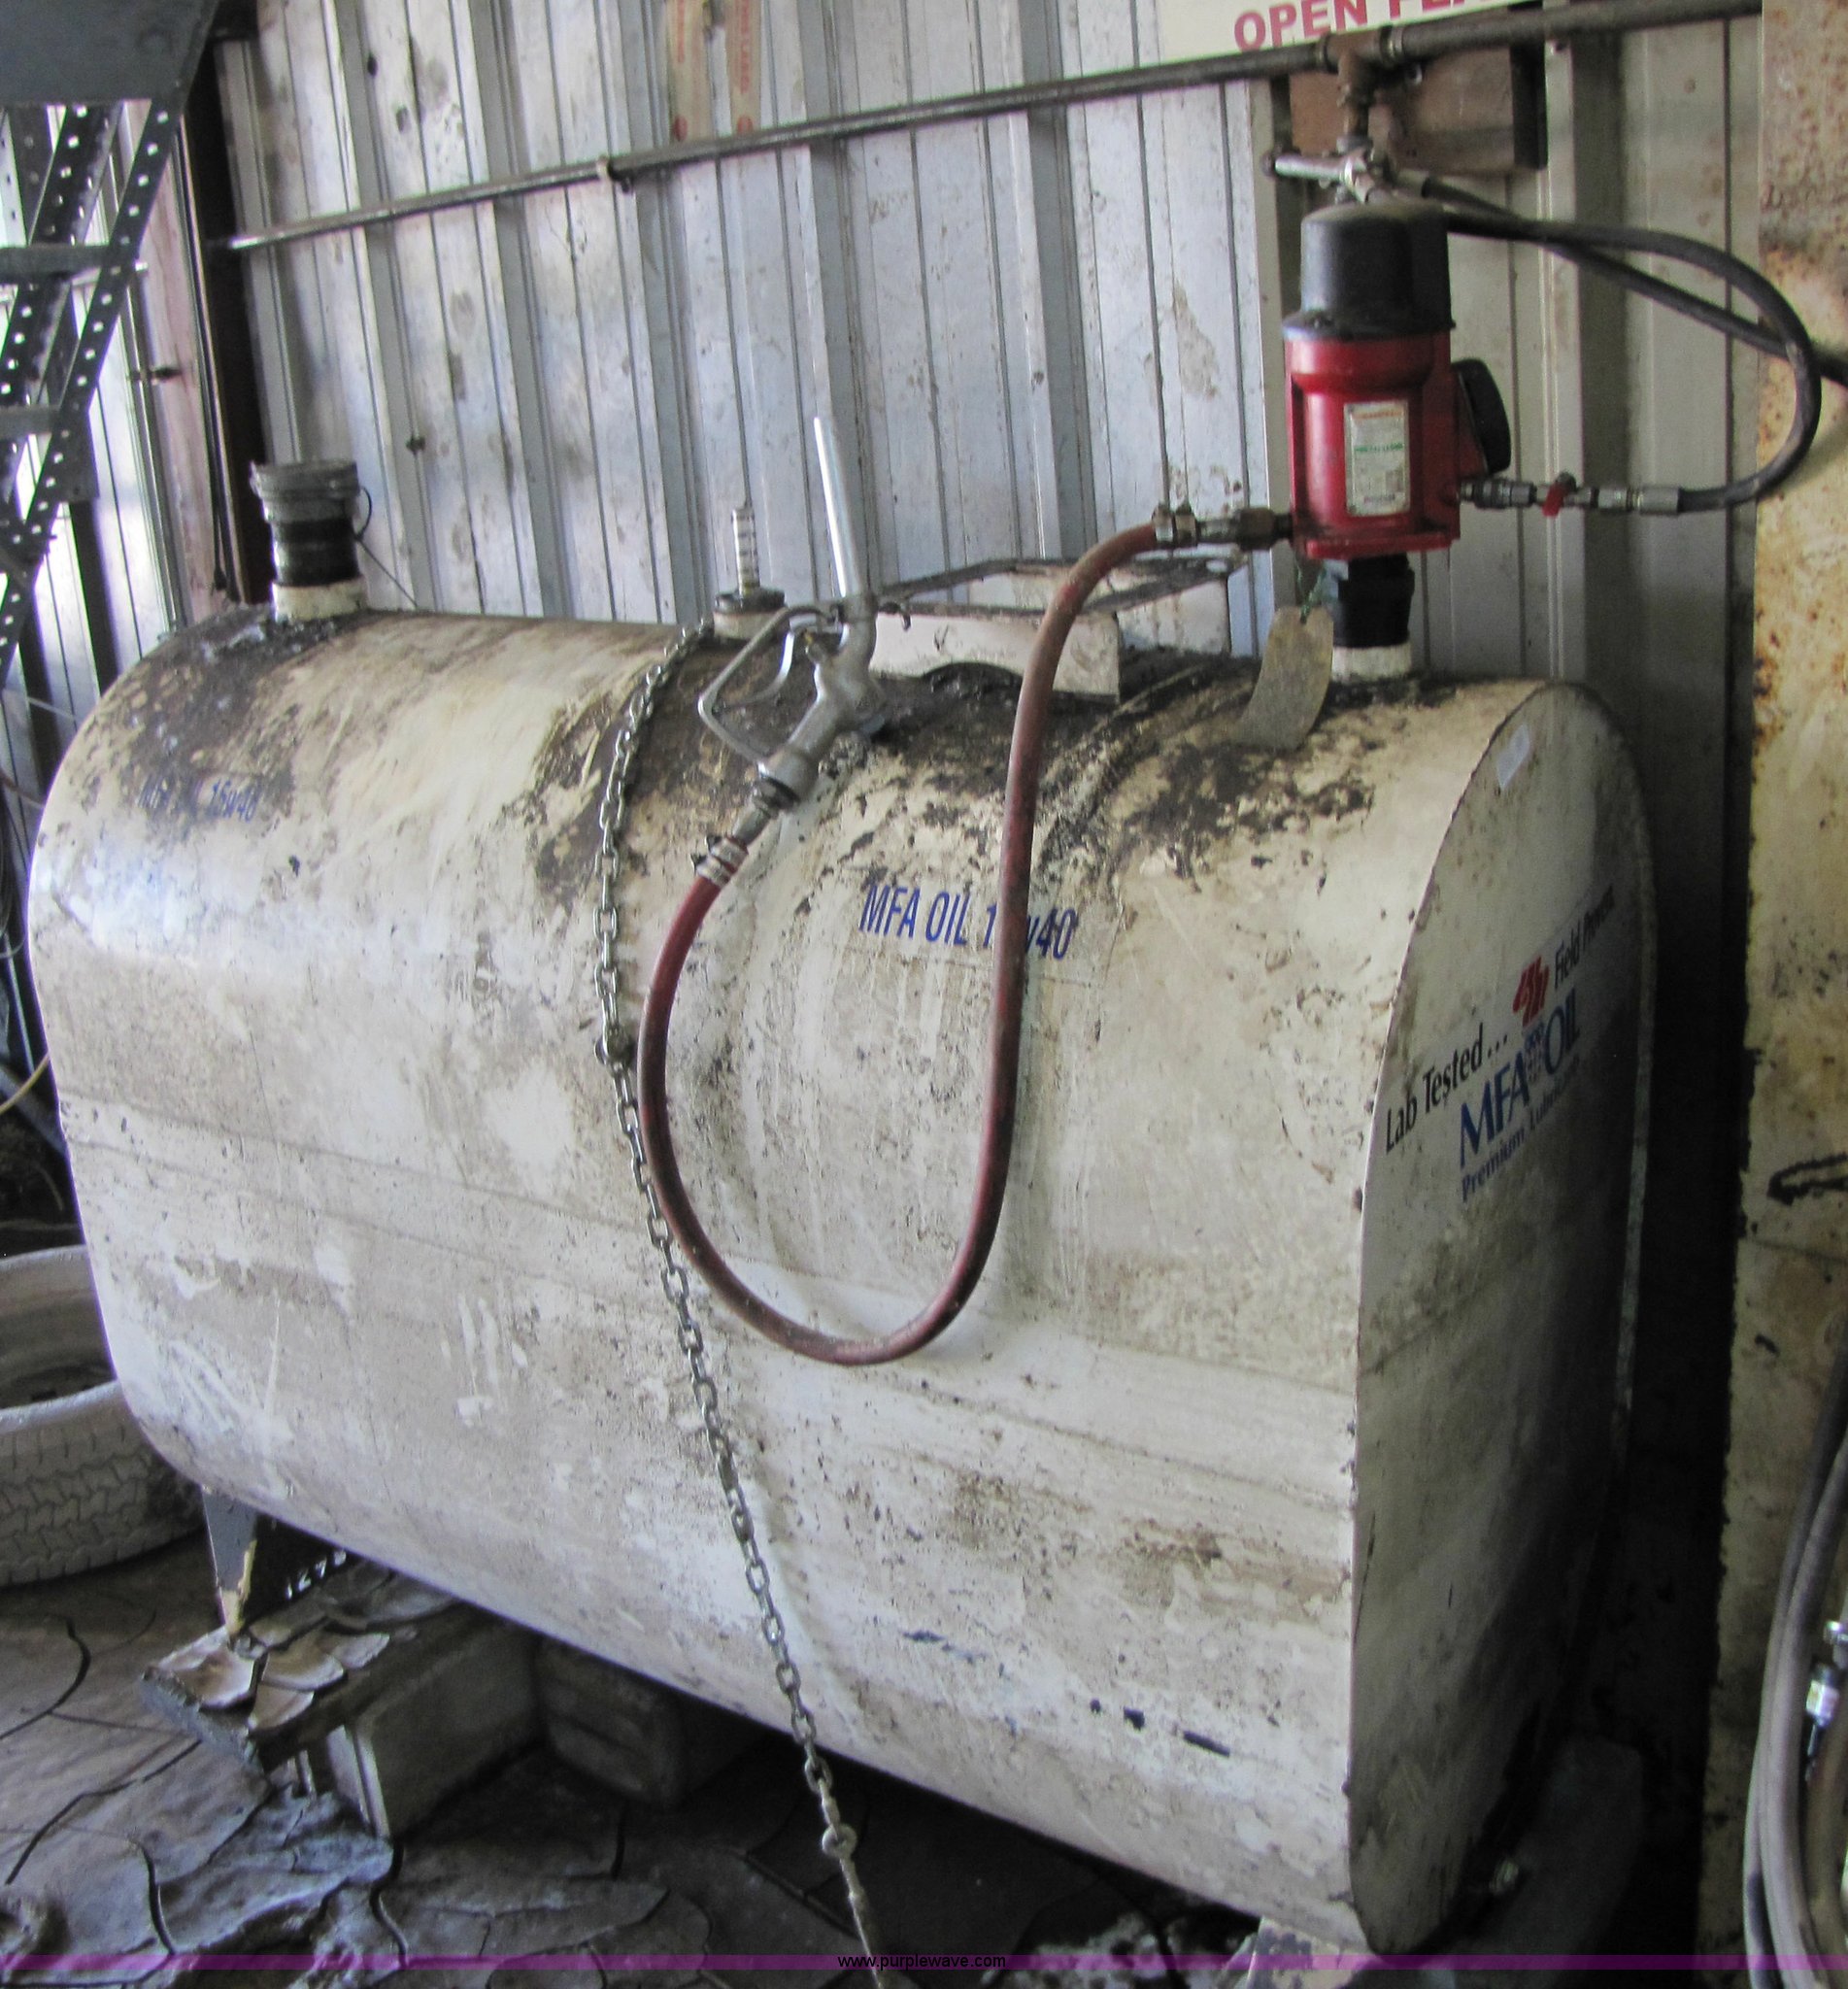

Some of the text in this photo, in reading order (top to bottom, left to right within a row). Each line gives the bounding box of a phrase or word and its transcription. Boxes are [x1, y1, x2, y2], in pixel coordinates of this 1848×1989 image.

[1233, 0, 1368, 52] OPEN
[858, 884, 921, 940] MFA
[925, 891, 970, 947] OIL
[1385, 1090, 1418, 1155] Lab
[1554, 919, 1581, 990] Field
[1460, 987, 1581, 1169] MFA OIL
[1462, 1128, 1526, 1204] Premium
